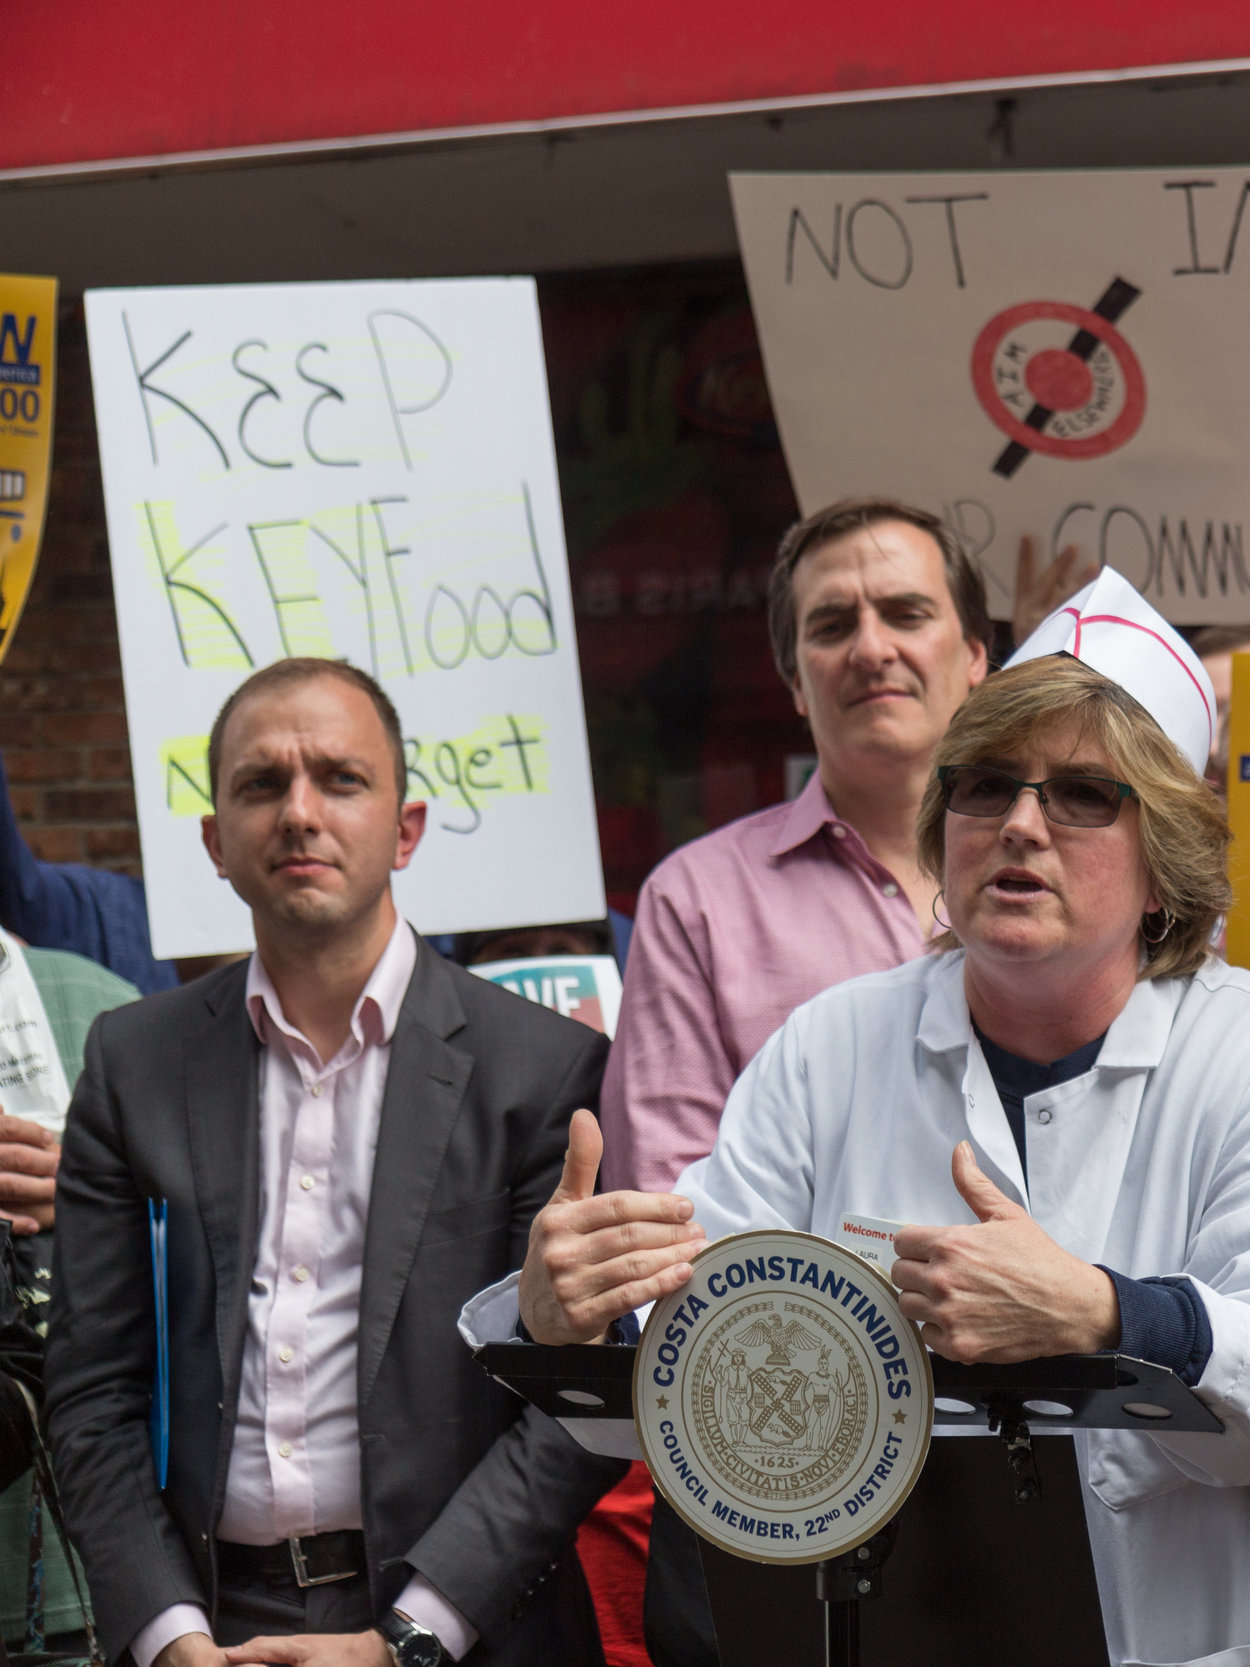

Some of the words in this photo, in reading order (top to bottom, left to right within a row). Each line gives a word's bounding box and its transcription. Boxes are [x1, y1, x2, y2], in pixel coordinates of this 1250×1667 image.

[786, 193, 989, 290] NOT
[122, 310, 453, 470] KEEP
[843, 1222, 887, 1240] Welcome
[855, 1249, 879, 1261] LAURA
[653, 1295, 710, 1387] COSTA
[707, 1255, 912, 1401] CONSTANTINIDES
[659, 1420, 707, 1507] COUNCIL
[711, 1500, 801, 1541] MEMBER,
[805, 1507, 841, 1537] 22ND
[843, 1431, 903, 1517] DISTRICT
[725, 1454, 800, 1490] CIVITATIS
[802, 1453, 838, 1485] NOVI
[834, 1393, 857, 1453] EBORACI
